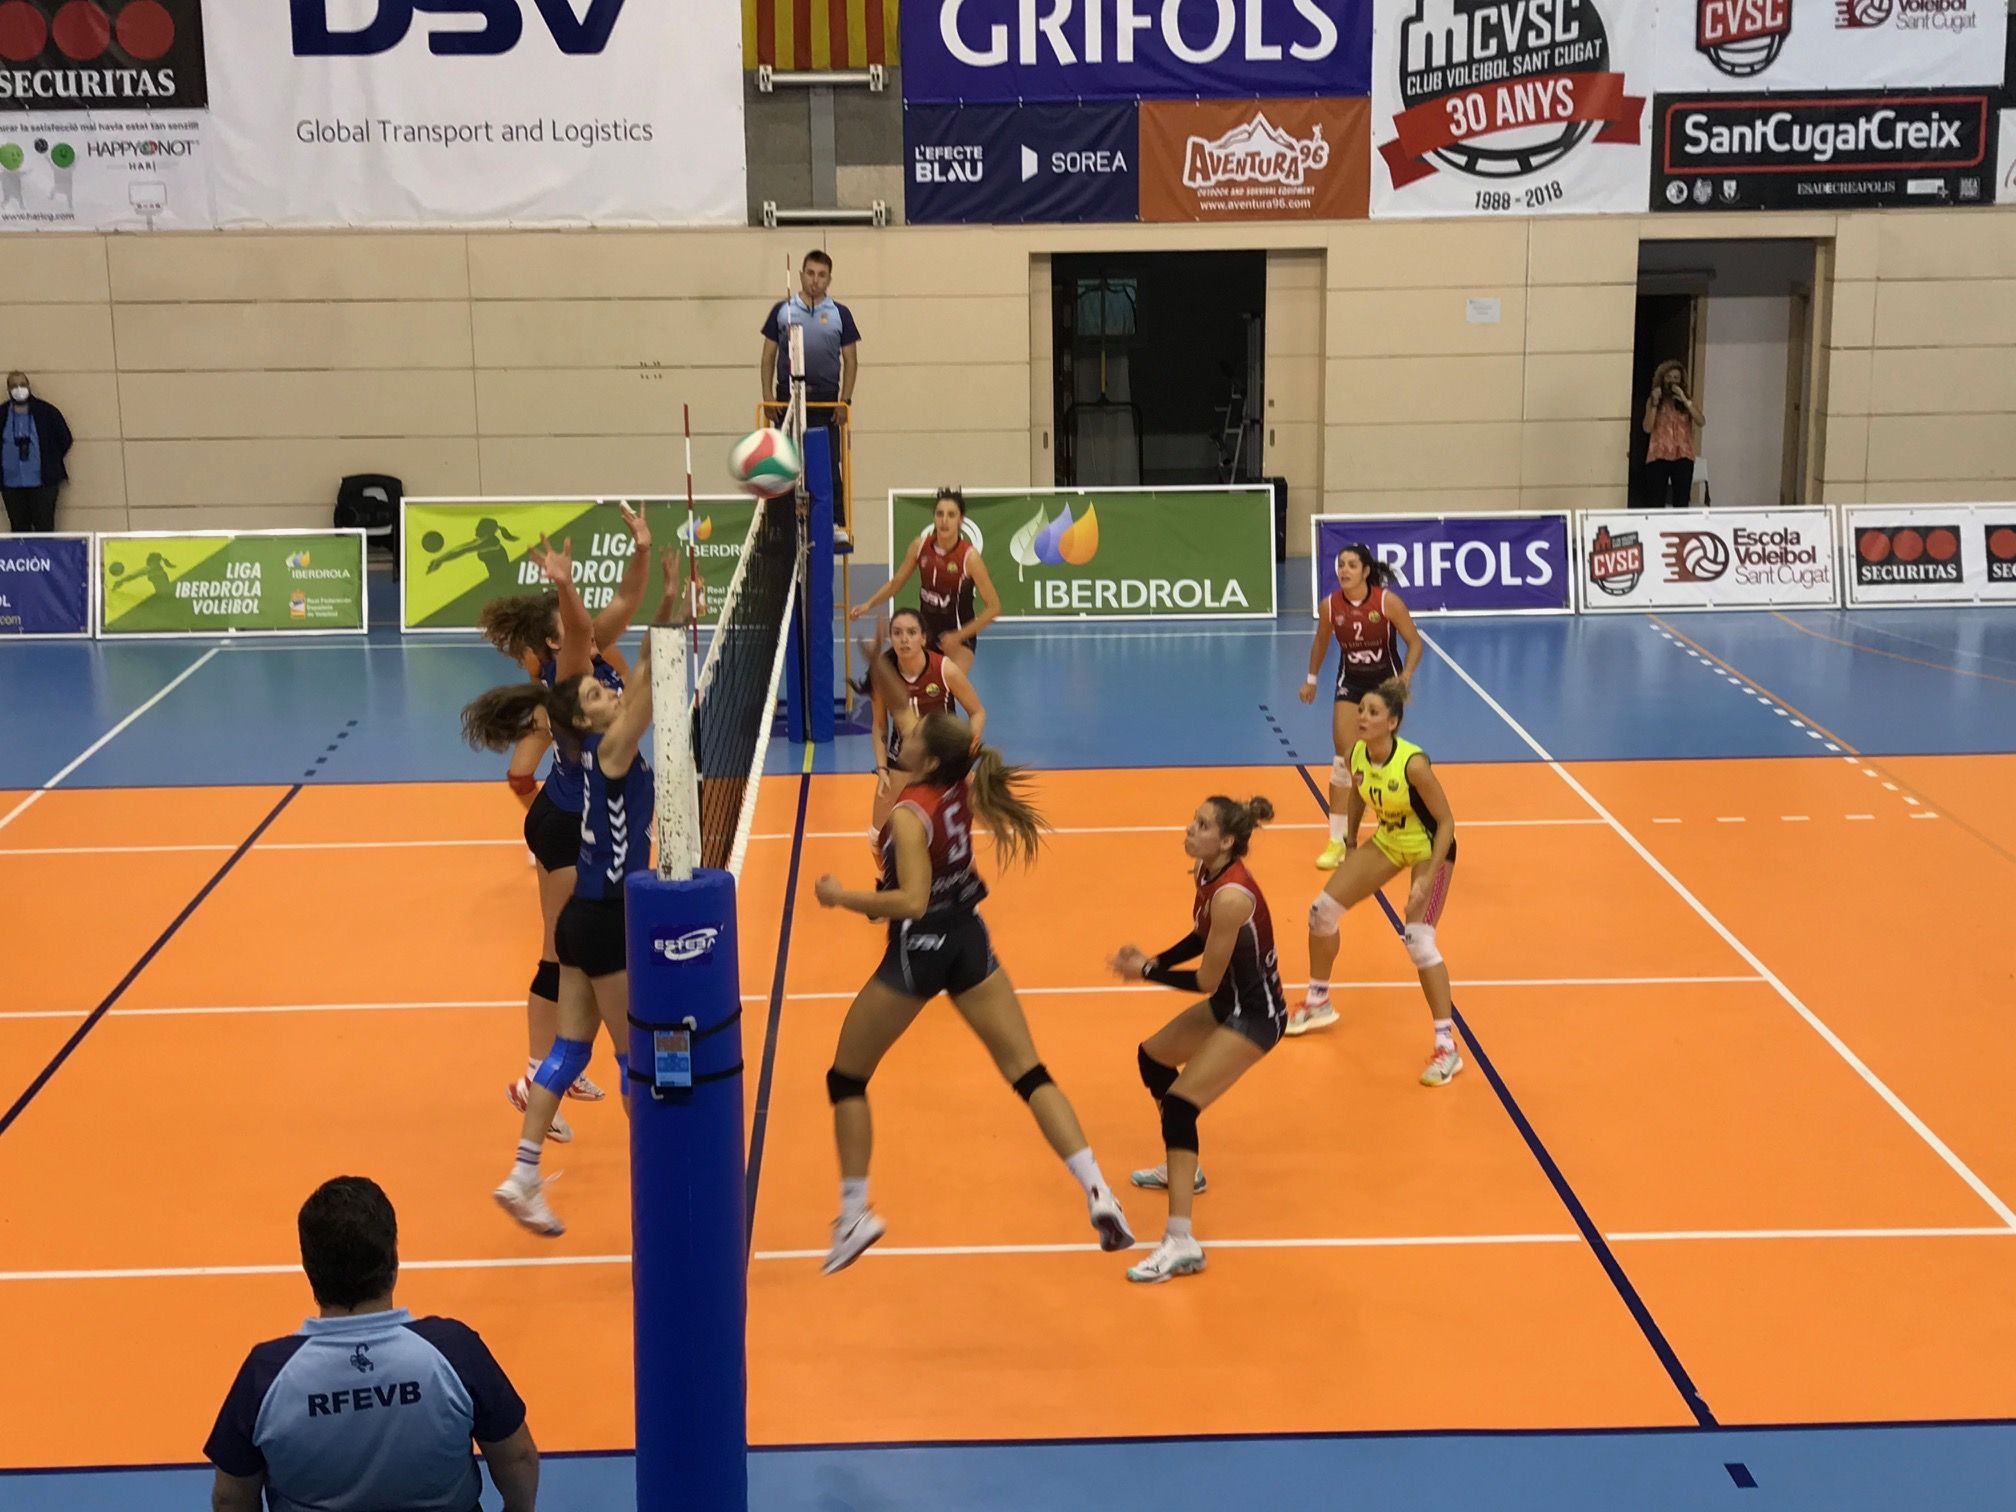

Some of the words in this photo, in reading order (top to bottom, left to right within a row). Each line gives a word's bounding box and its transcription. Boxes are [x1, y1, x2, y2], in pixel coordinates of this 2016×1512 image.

[1473, 0, 1580, 59] CVSC
[1704, 0, 1785, 40] CVSC
[1896, 11, 1930, 31] Sant
[1932, 11, 1976, 34] Cugat
[939, 0, 1338, 66] GRIFOLS
[1407, 67, 1442, 95] CLUB
[1447, 58, 1510, 88] VOLEIBOL
[1513, 52, 1551, 75] SANT
[1554, 38, 1603, 67] CUGAT
[0, 68, 176, 98] SECURITAS
[1446, 92, 1487, 136] 30
[1496, 78, 1574, 127] ANYS
[296, 118, 371, 144] Global
[376, 118, 494, 148] Transport
[501, 118, 544, 143] and
[552, 117, 654, 149] Logistics
[915, 144, 983, 160] L'EFECTE
[1051, 150, 1128, 173] SOREA
[915, 160, 983, 183] BLAU
[1199, 196, 1312, 211] www.aventura96.com
[1475, 190, 1512, 210] 1988
[1525, 180, 1563, 208] 2018
[1733, 526, 1801, 546] Escola
[1594, 547, 1640, 577] CVSC
[1734, 544, 1817, 565] Voleibol
[226, 561, 262, 579] LIGA
[291, 568, 351, 579] IBERDROLA
[1735, 563, 1775, 585] Sant
[1777, 563, 1831, 589] Cugat
[1861, 563, 1958, 582] SECURITAS
[175, 580, 262, 599] IBERDROLA
[1034, 578, 1250, 609] IBERDROLA
[192, 598, 260, 615] VOLEIBOL
[1353, 621, 1365, 641] 2
[942, 802, 969, 865] 5
[307, 1380, 422, 1417] RFEVB
